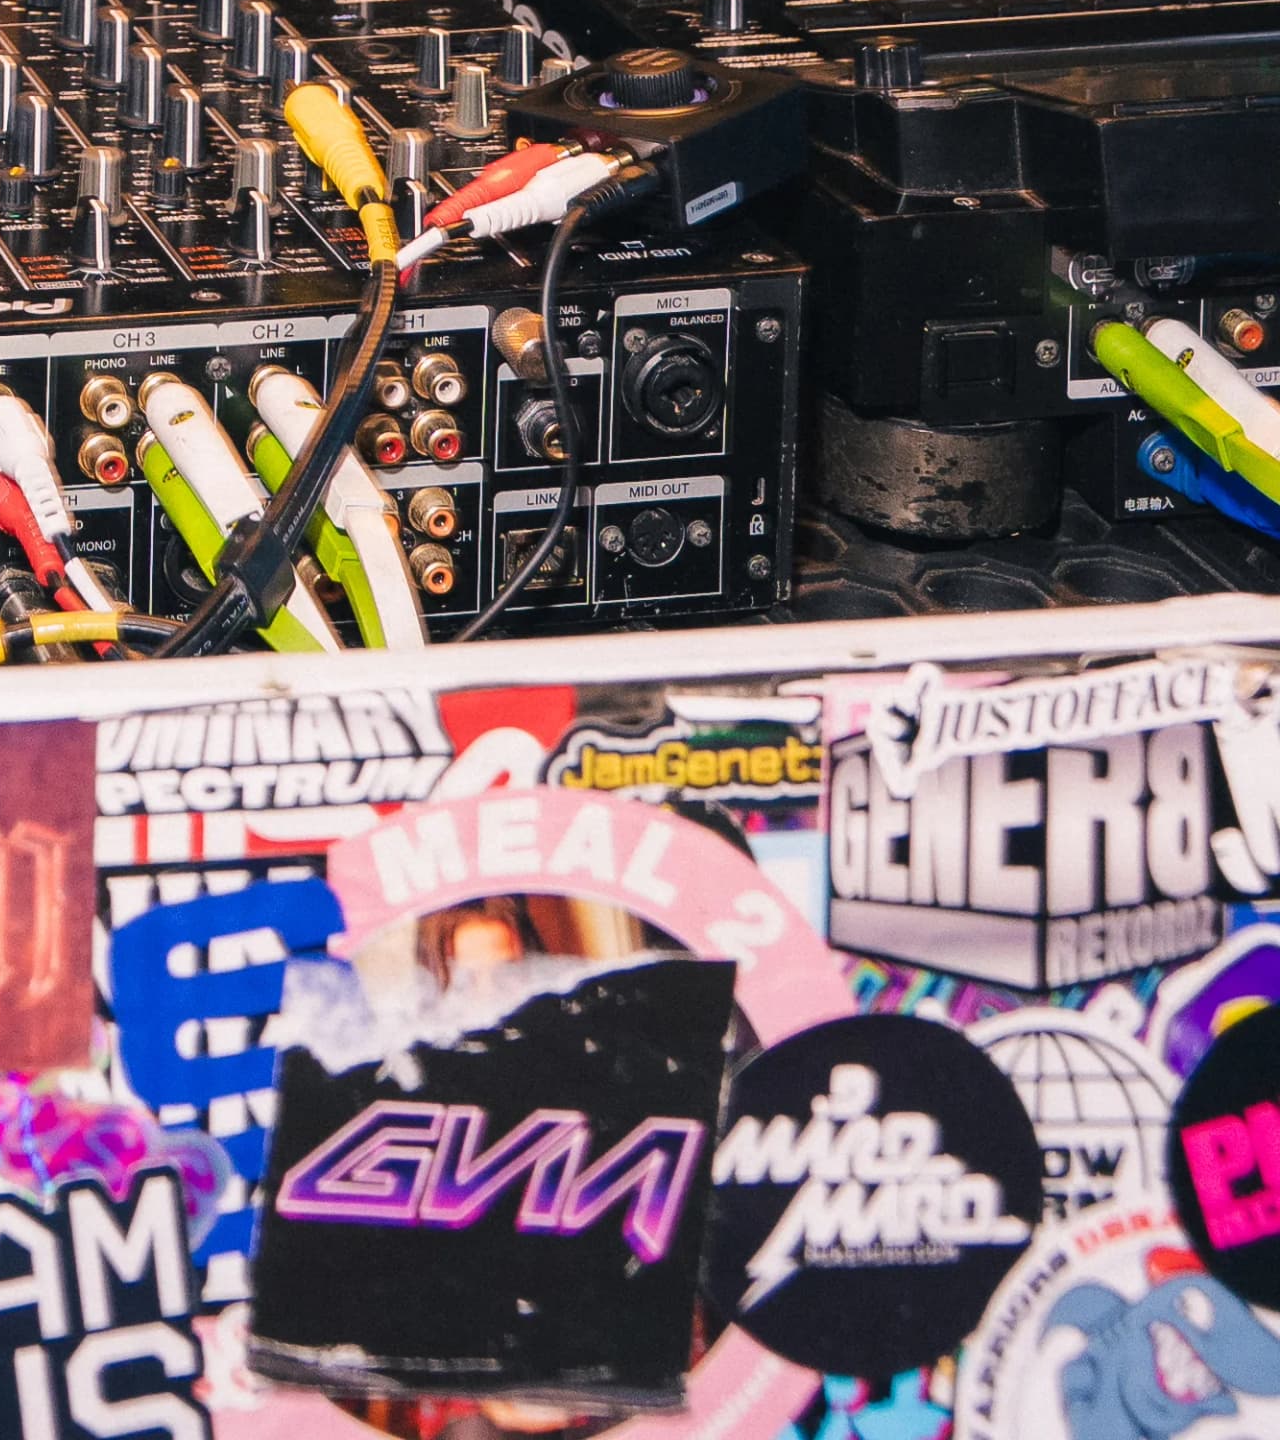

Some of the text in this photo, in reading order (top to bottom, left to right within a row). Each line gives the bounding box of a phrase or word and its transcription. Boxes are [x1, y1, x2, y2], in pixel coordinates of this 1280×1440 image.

[670, 313, 725, 326] BALANCED
[113, 332, 156, 349] CH 3
[424, 335, 450, 348] LINE
[259, 347, 286, 359] LINE
[83, 358, 127, 370] PHONO
[149, 354, 176, 366] LINE
[404, 357, 412, 367] L
[296, 365, 303, 375] L
[129, 375, 137, 386] L
[128, 467, 136, 478] R
[453, 487, 458, 497] 1
[629, 482, 690, 497] MIDI OUT
[526, 492, 559, 507] LINK
[1124, 497, 1175, 512] 电源输入
[369, 795, 680, 908] MEAL
